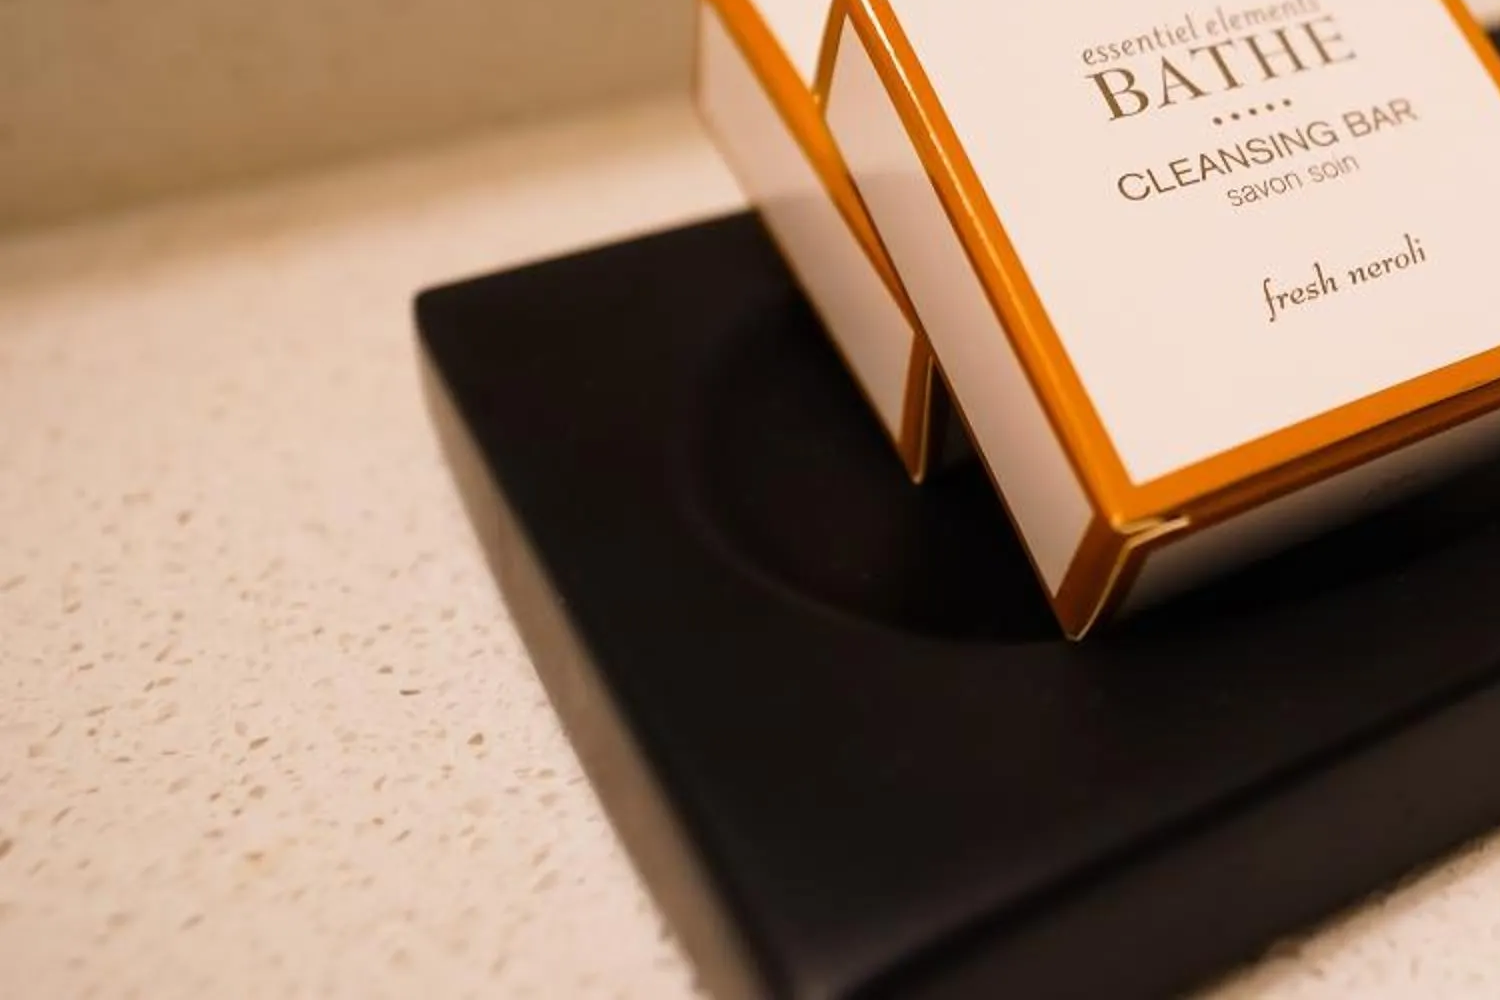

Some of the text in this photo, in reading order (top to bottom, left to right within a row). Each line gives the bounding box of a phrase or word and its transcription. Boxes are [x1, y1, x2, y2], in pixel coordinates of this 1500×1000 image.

[1081, 13, 1199, 67] essentiel
[1084, 14, 1357, 122] BATHE
[1117, 98, 1419, 201] CLEANSING BAR
[1225, 155, 1360, 207] savon soin
[1263, 233, 1427, 323] fresh neroli
